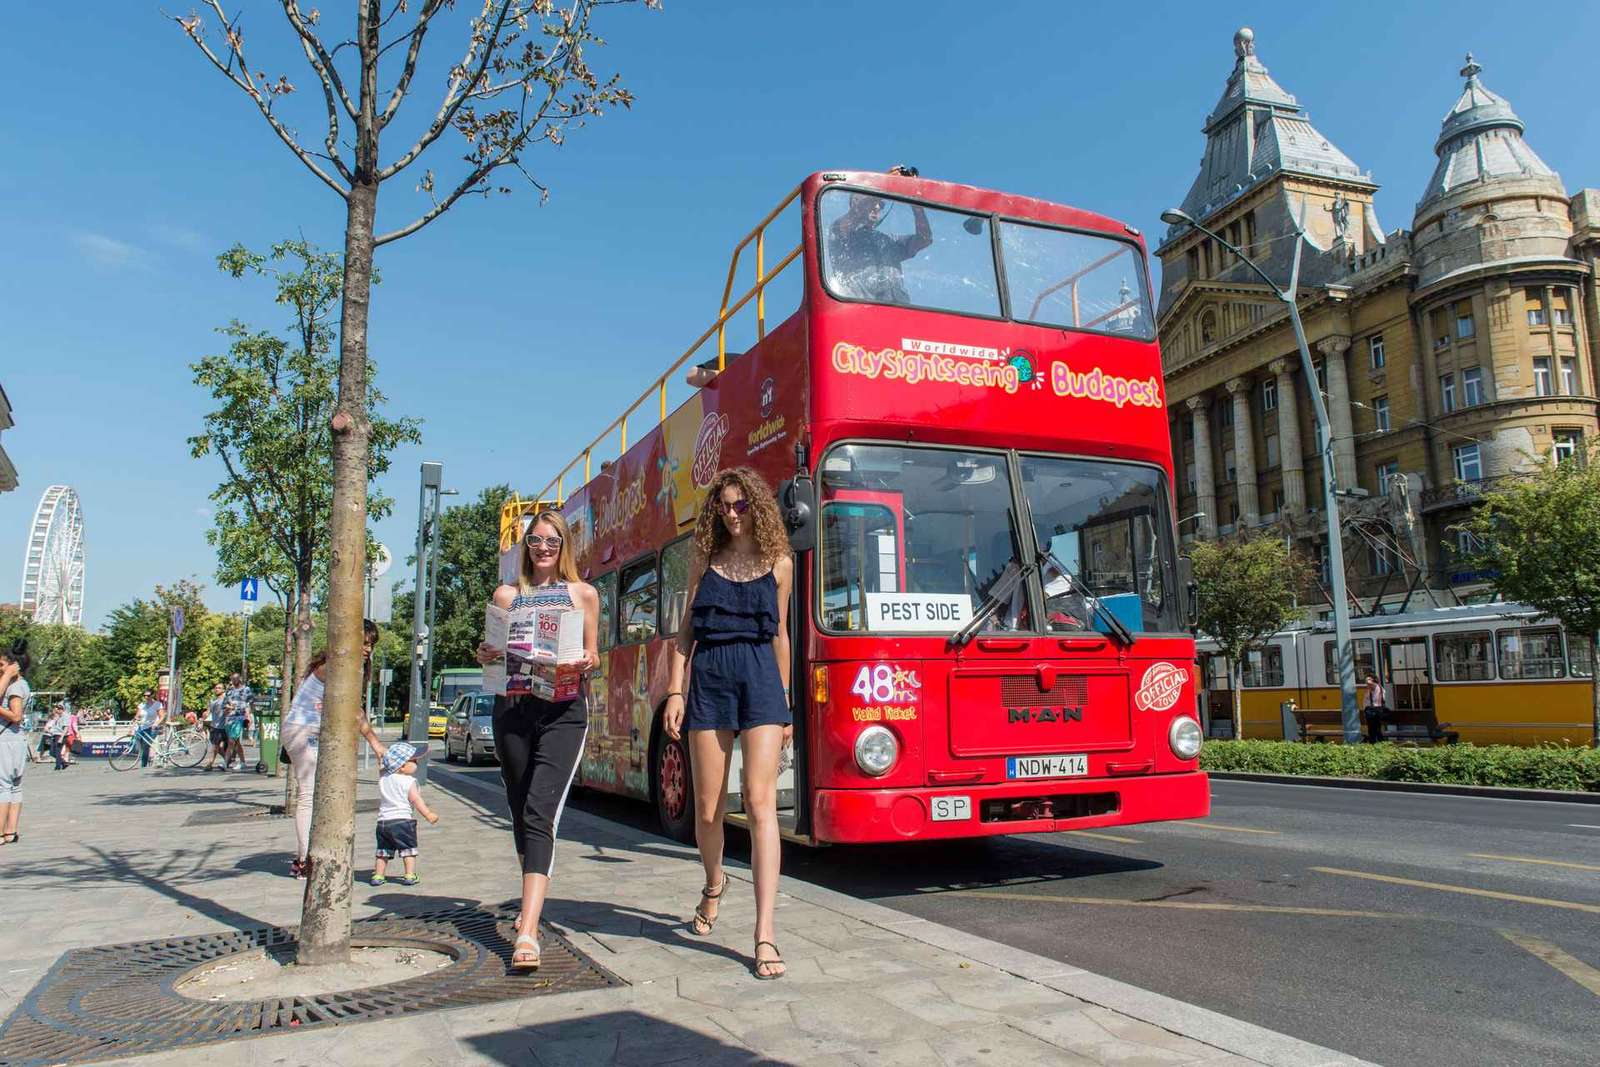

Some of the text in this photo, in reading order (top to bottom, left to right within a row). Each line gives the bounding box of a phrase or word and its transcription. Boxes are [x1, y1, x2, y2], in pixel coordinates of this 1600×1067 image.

[910, 340, 996, 360] Worldwide
[1051, 360, 1162, 408] Budapest
[693, 418, 727, 483] OFFICIAL
[880, 602, 961, 621] PEST SIDE
[538, 621, 558, 632] 100
[851, 664, 894, 703] 48
[1141, 670, 1186, 705] OFFICIAL
[1156, 688, 1178, 707] TOUR
[852, 704, 917, 721] Valid Ticket
[1018, 758, 1085, 777] NDW-414
[937, 799, 966, 818] SP
